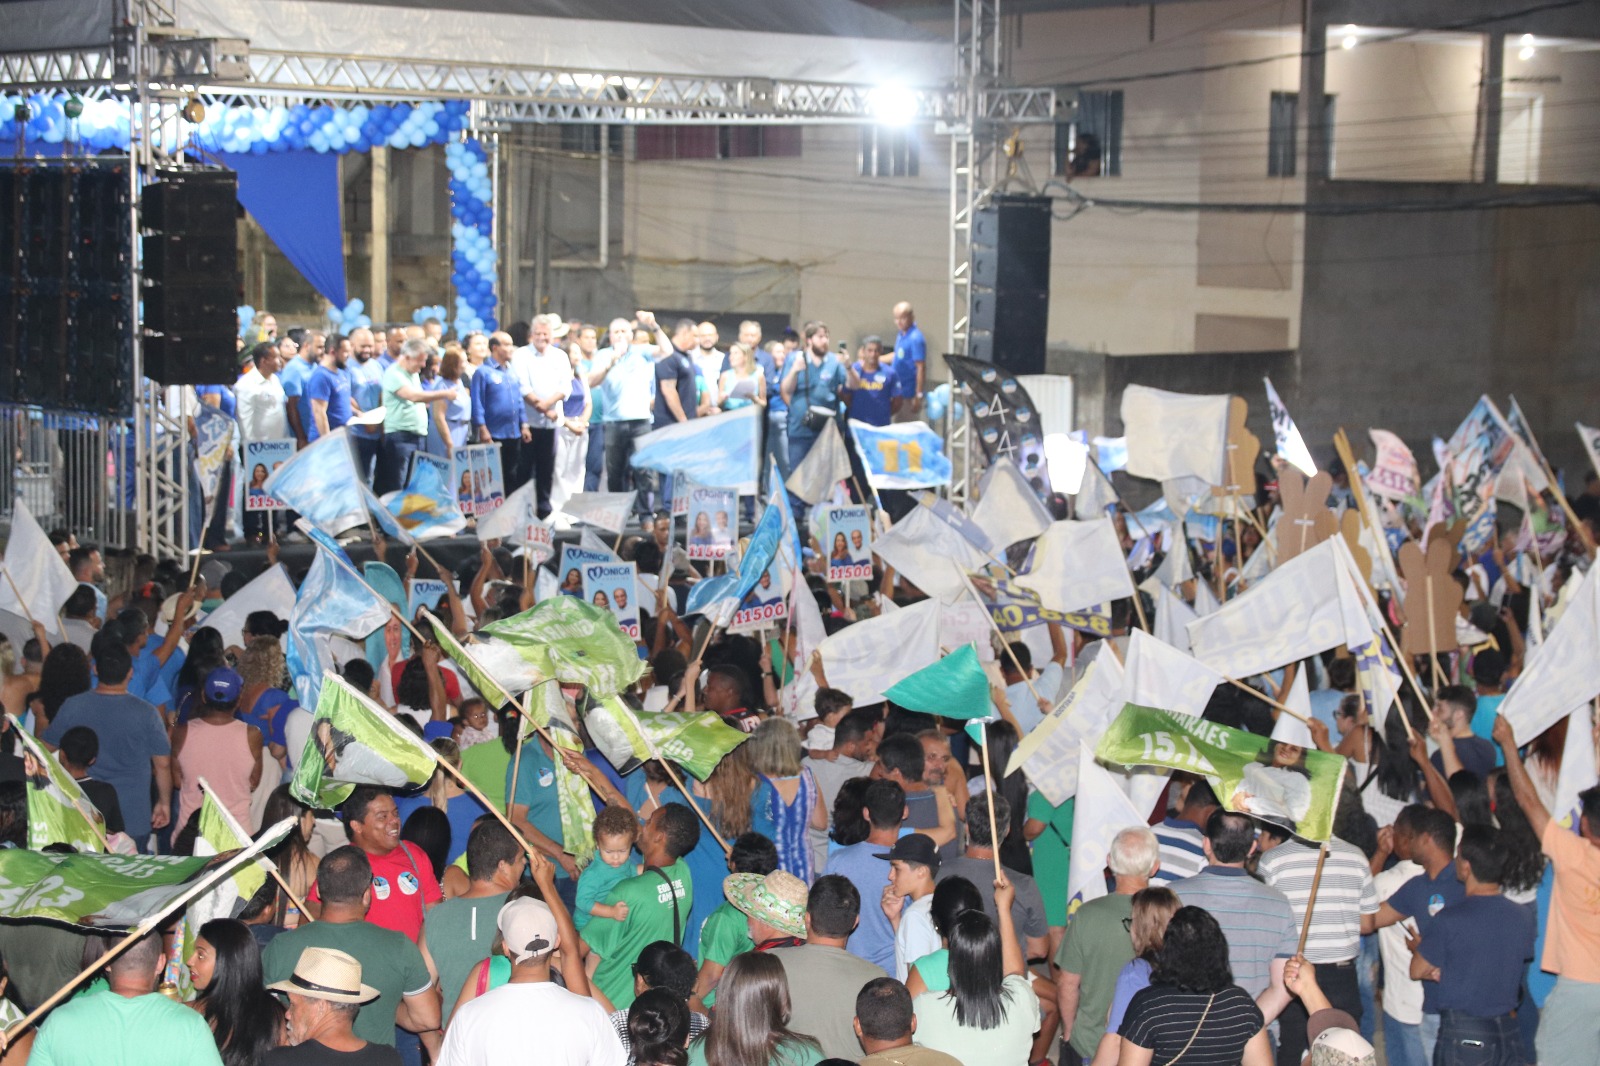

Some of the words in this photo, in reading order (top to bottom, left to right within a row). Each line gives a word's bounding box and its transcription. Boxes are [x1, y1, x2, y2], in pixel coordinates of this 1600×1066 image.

[248, 442, 290, 455] MONICA
[877, 439, 923, 473] 11
[830, 509, 866, 523] MONICA
[566, 548, 610, 562] MONICA
[588, 566, 630, 582] MONICA
[830, 565, 872, 579] 11500
[736, 603, 785, 624] 11500
